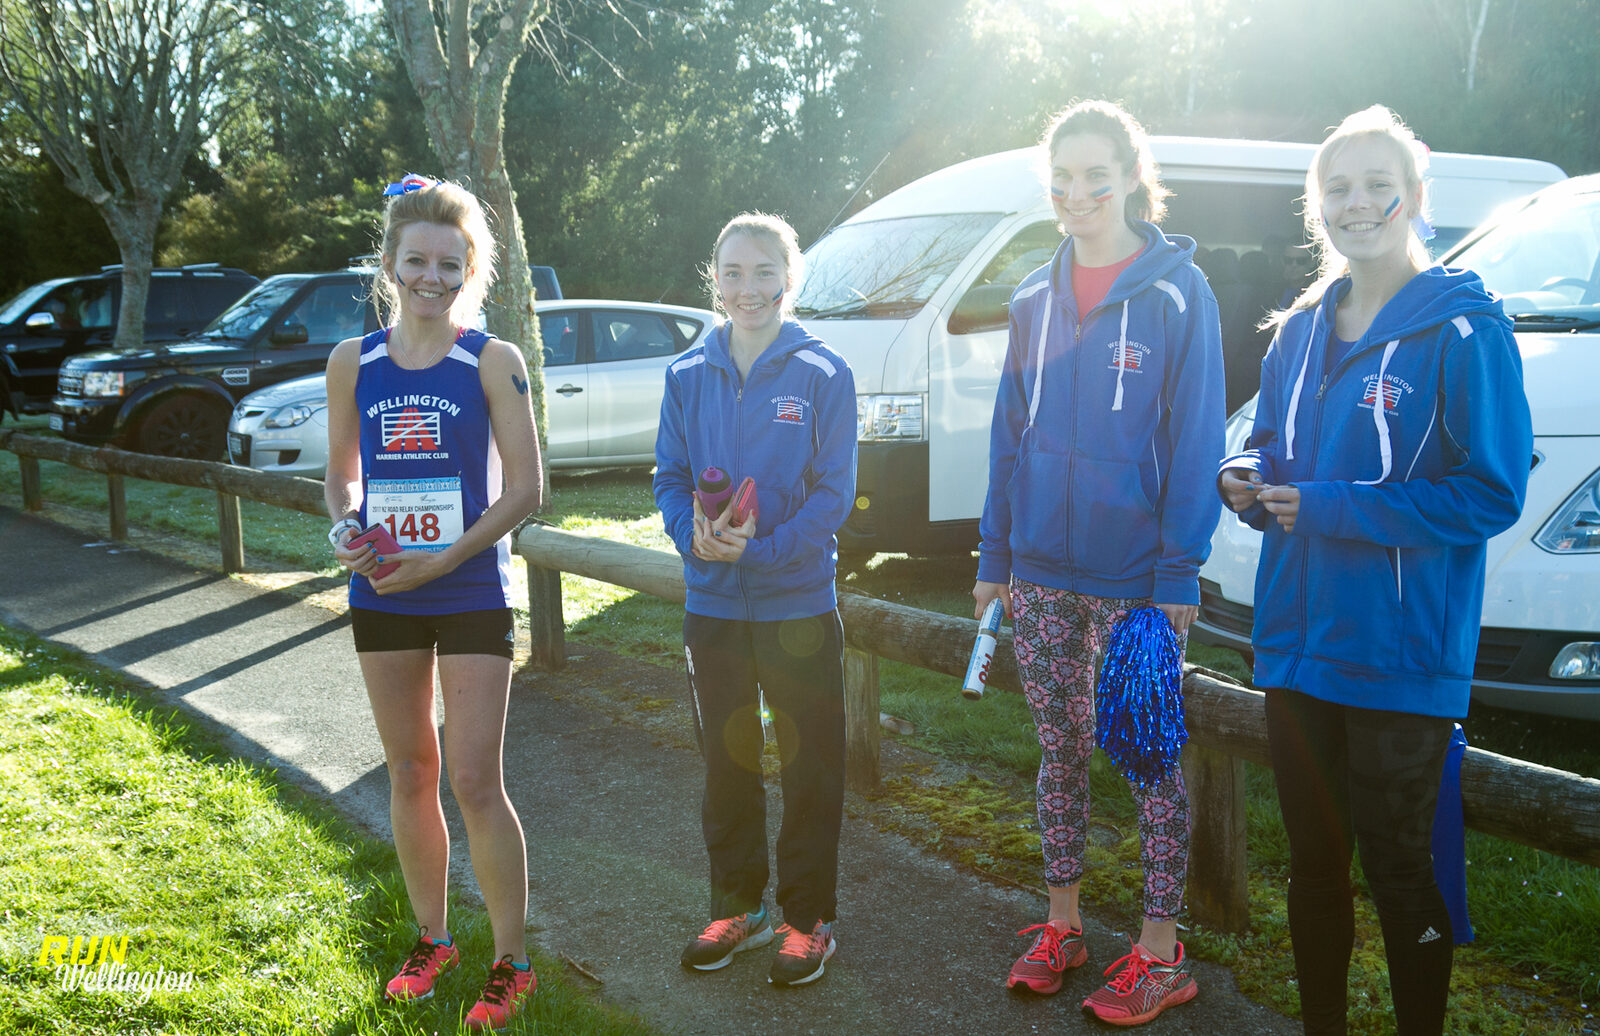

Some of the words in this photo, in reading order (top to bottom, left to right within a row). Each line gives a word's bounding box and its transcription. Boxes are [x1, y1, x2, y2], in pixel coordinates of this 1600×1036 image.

[1107, 340, 1152, 355] WEINGTON
[1362, 373, 1414, 394] WELINGTON
[366, 394, 461, 419] WELLINGTON
[770, 395, 810, 407] WELLINGTON
[375, 452, 402, 461] HARRIER
[403, 452, 432, 460] ATHLETIC
[399, 505, 414, 513] RELAY
[414, 503, 454, 512] CHAMPIONSHIPS
[385, 512, 441, 542] 148
